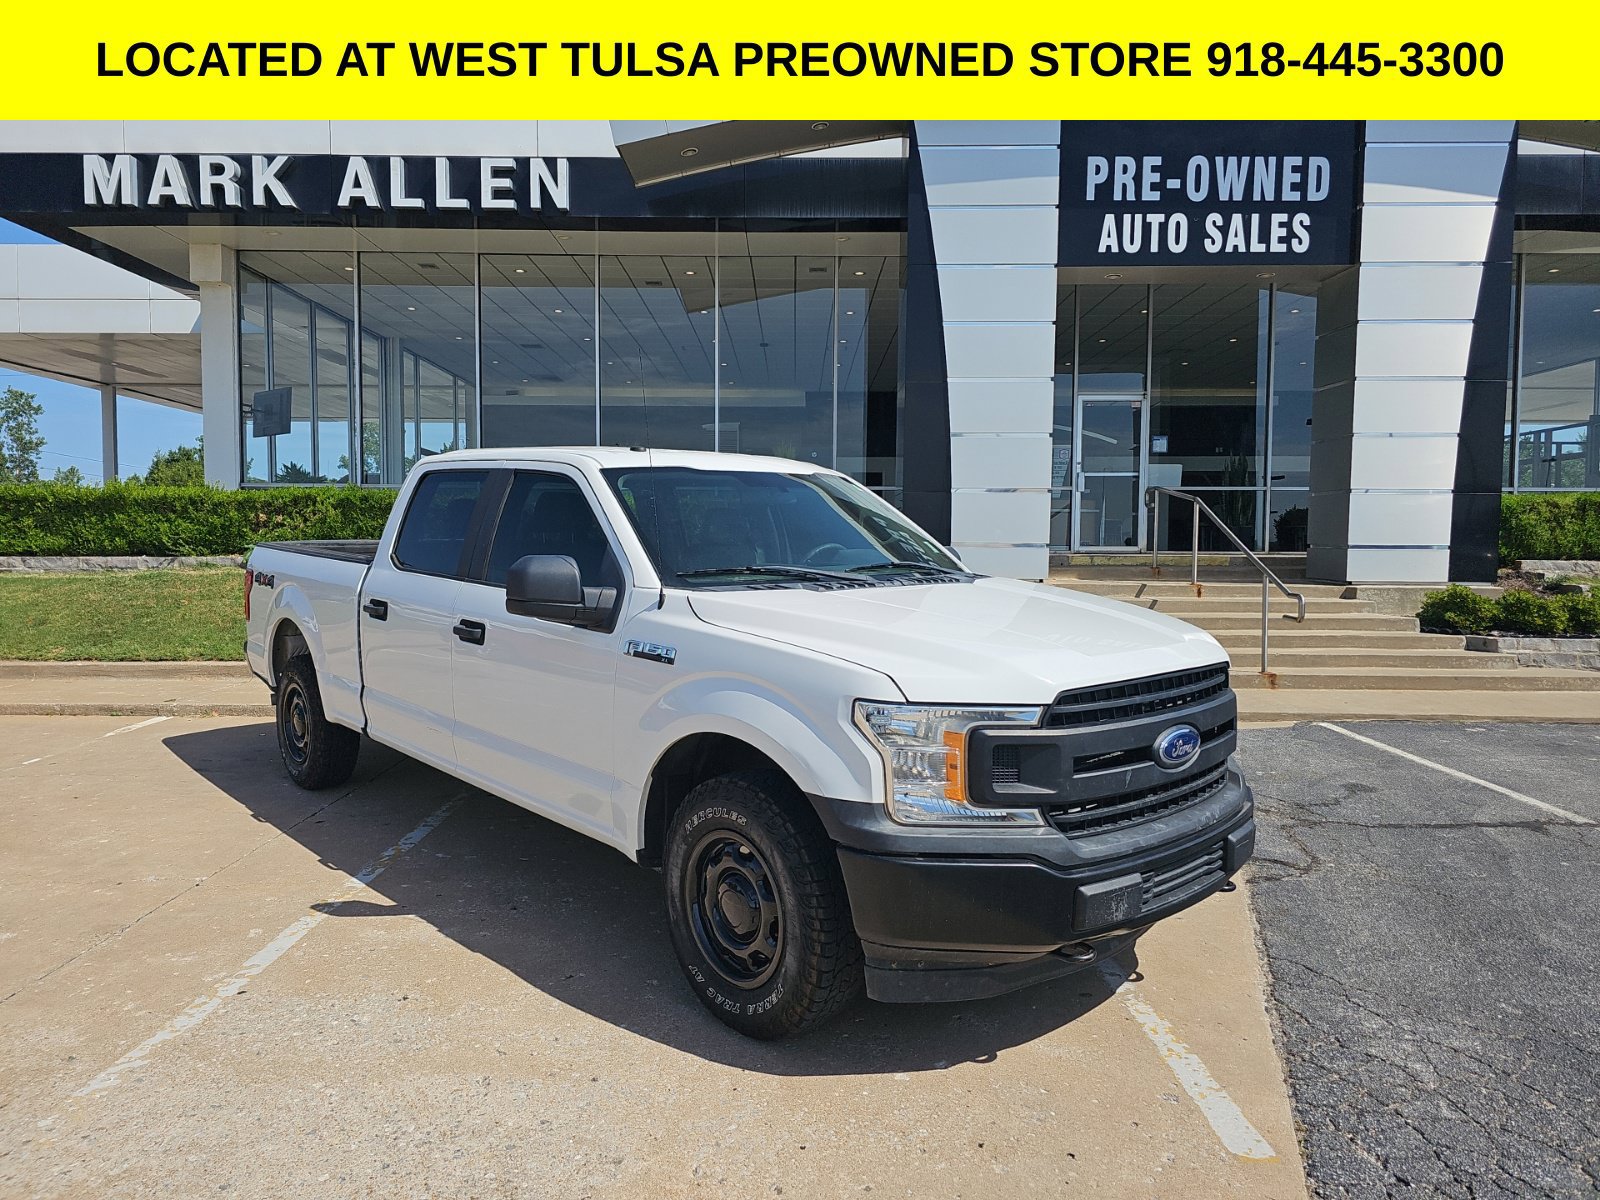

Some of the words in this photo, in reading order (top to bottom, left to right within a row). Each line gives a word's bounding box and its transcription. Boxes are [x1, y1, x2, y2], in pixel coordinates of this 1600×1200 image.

[82, 153, 298, 209] MARK
[337, 155, 571, 213] ALLEN
[1085, 155, 1331, 203] PRE-OWNED
[1098, 212, 1189, 254] AUTO
[1204, 212, 1311, 254] SALES
[1171, 738, 1194, 758] Ford
[684, 807, 748, 835] HERCULES
[706, 986, 741, 1015] TRAC
[746, 983, 785, 1016] TERRA
